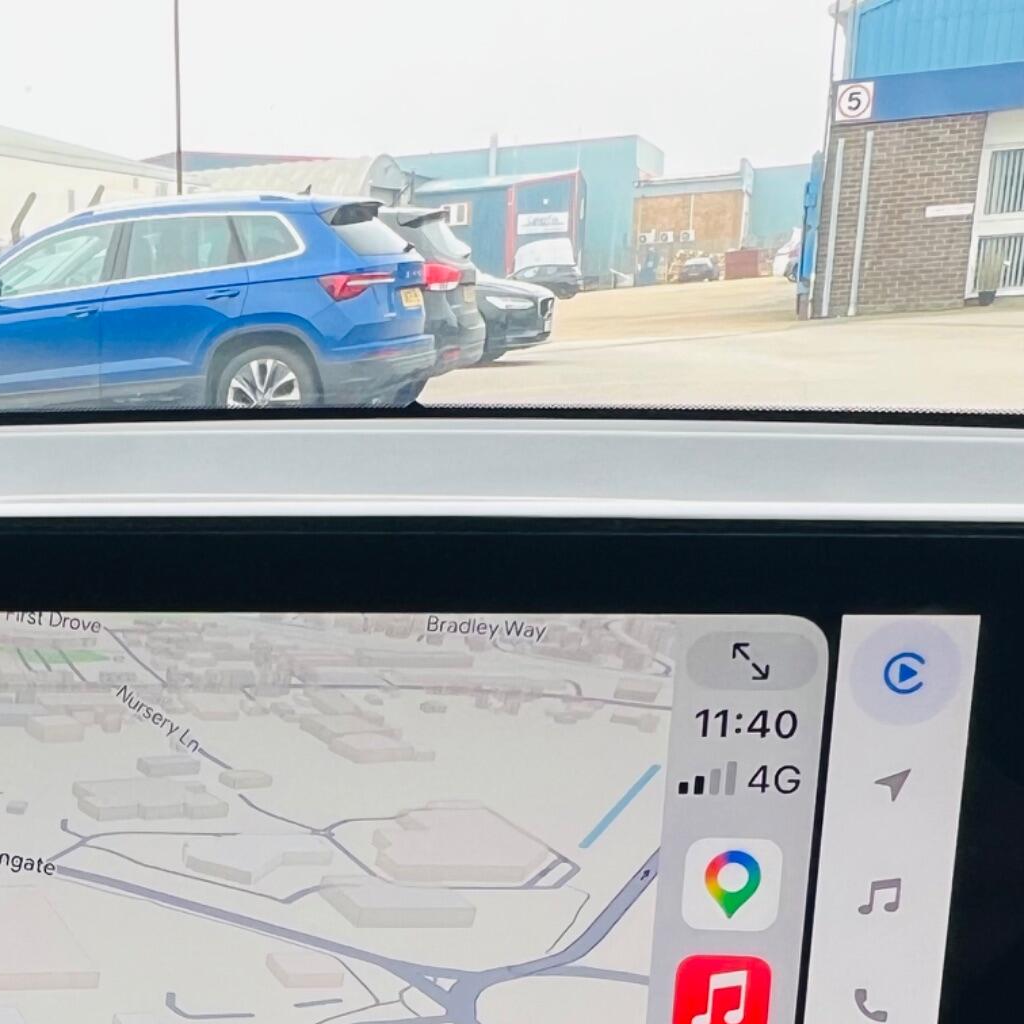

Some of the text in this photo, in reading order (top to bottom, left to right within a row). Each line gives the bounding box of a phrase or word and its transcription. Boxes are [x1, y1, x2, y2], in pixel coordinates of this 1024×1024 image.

[847, 92, 861, 111] 5
[49, 611, 101, 633] Drove
[427, 615, 546, 642] Bradley Way
[115, 684, 200, 753] Nursery Ln
[694, 708, 798, 739] 11:40
[747, 764, 801, 795] 4G
